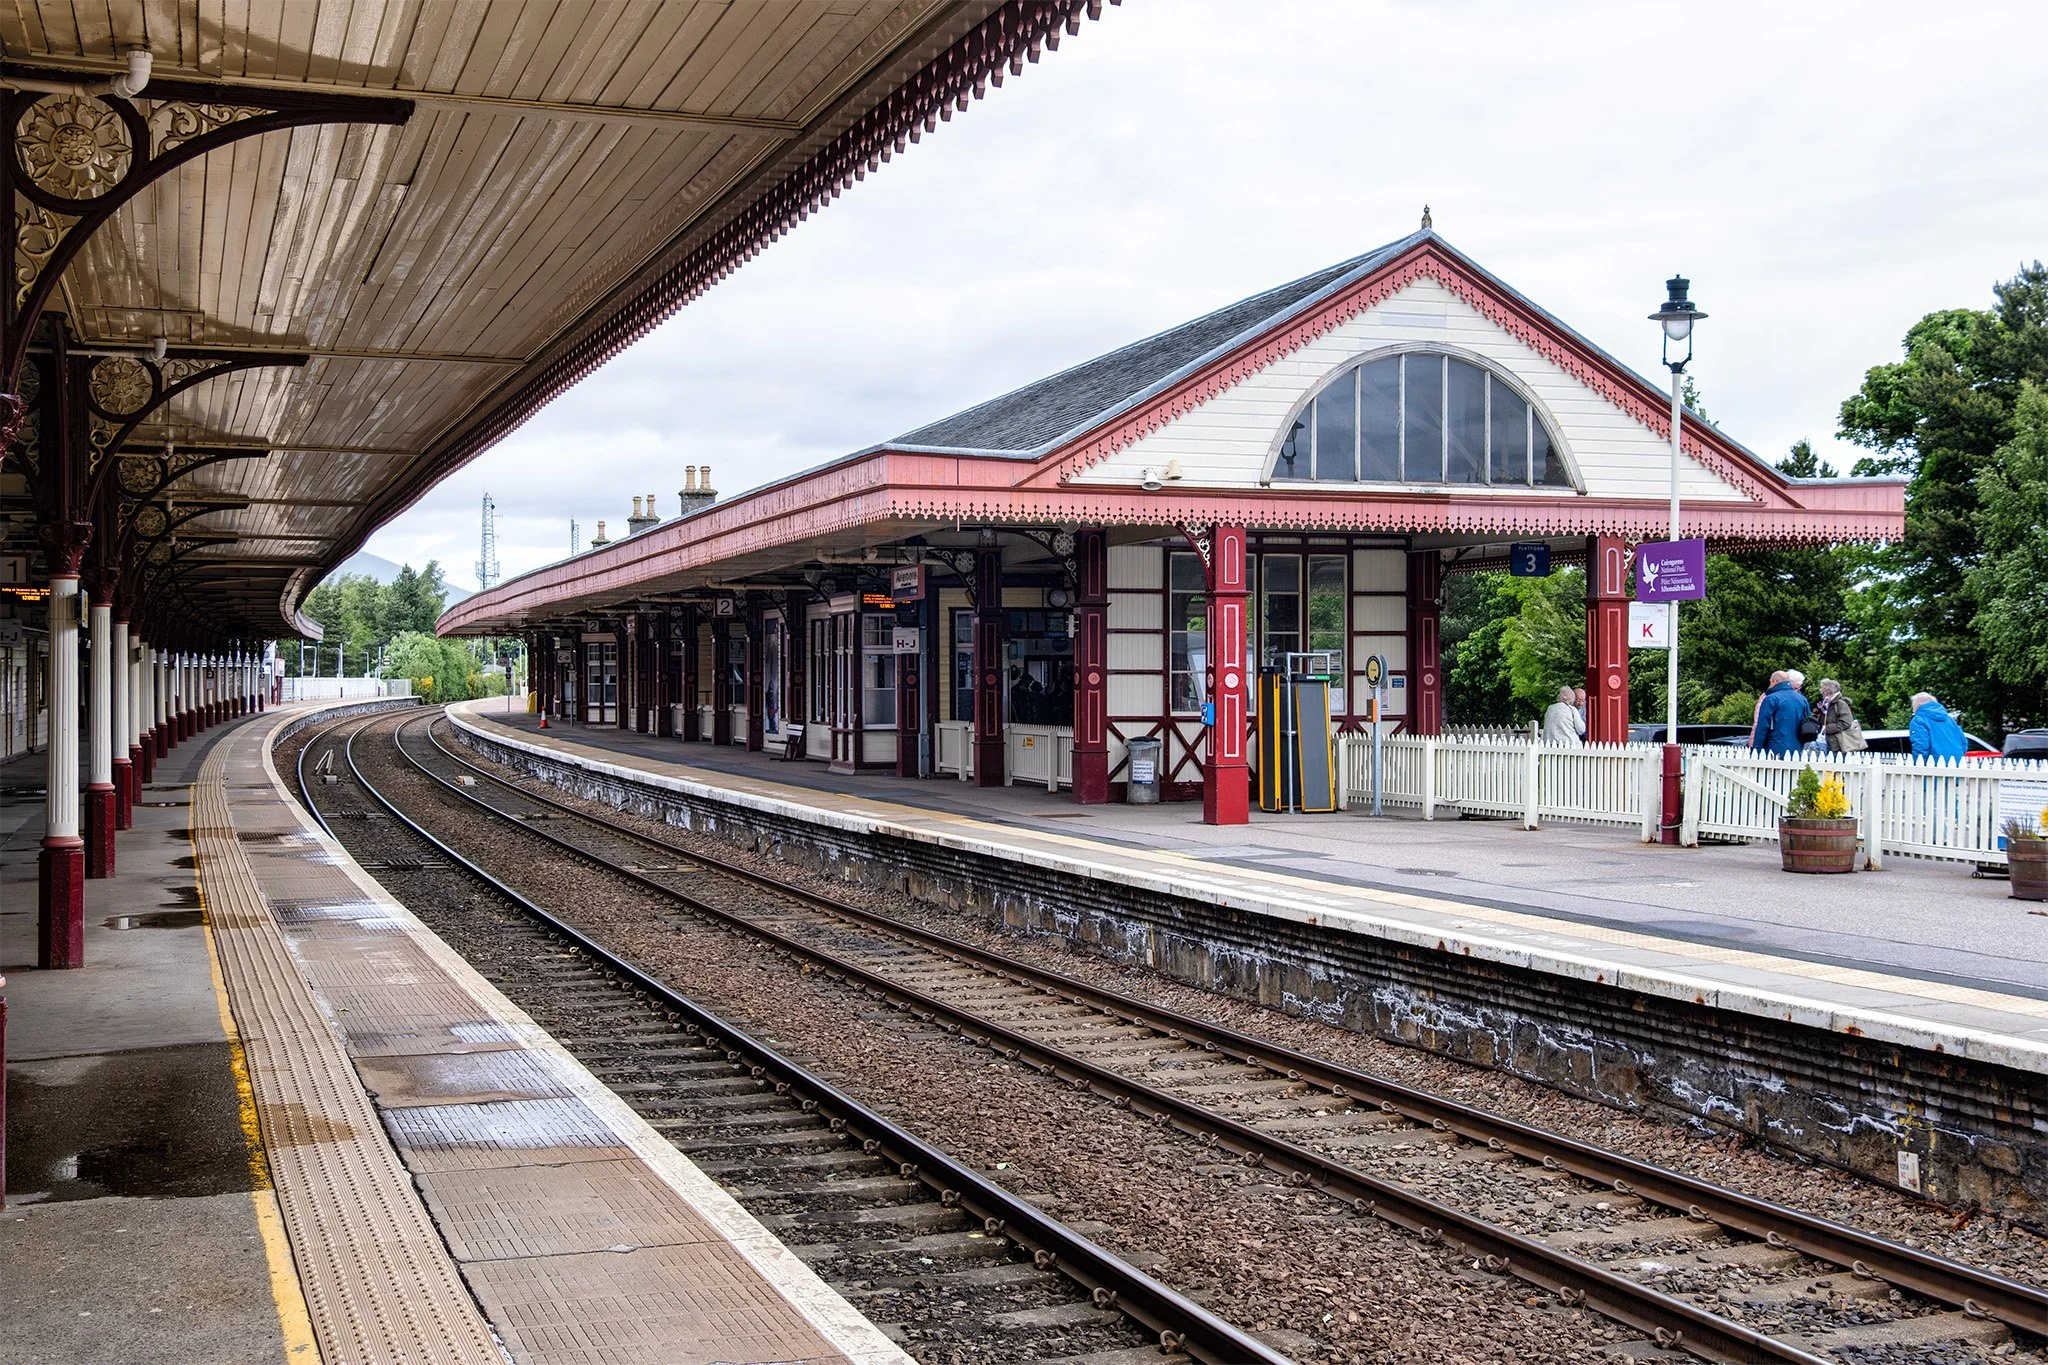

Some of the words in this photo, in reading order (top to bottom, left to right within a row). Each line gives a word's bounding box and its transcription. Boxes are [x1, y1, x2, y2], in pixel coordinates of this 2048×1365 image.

[1525, 553, 1537, 573] 3
[7, 560, 18, 582] 1
[720, 600, 730, 614] 2
[589, 621, 597, 631] 2
[1642, 623, 1654, 638] K
[896, 639, 916, 648] H-J
